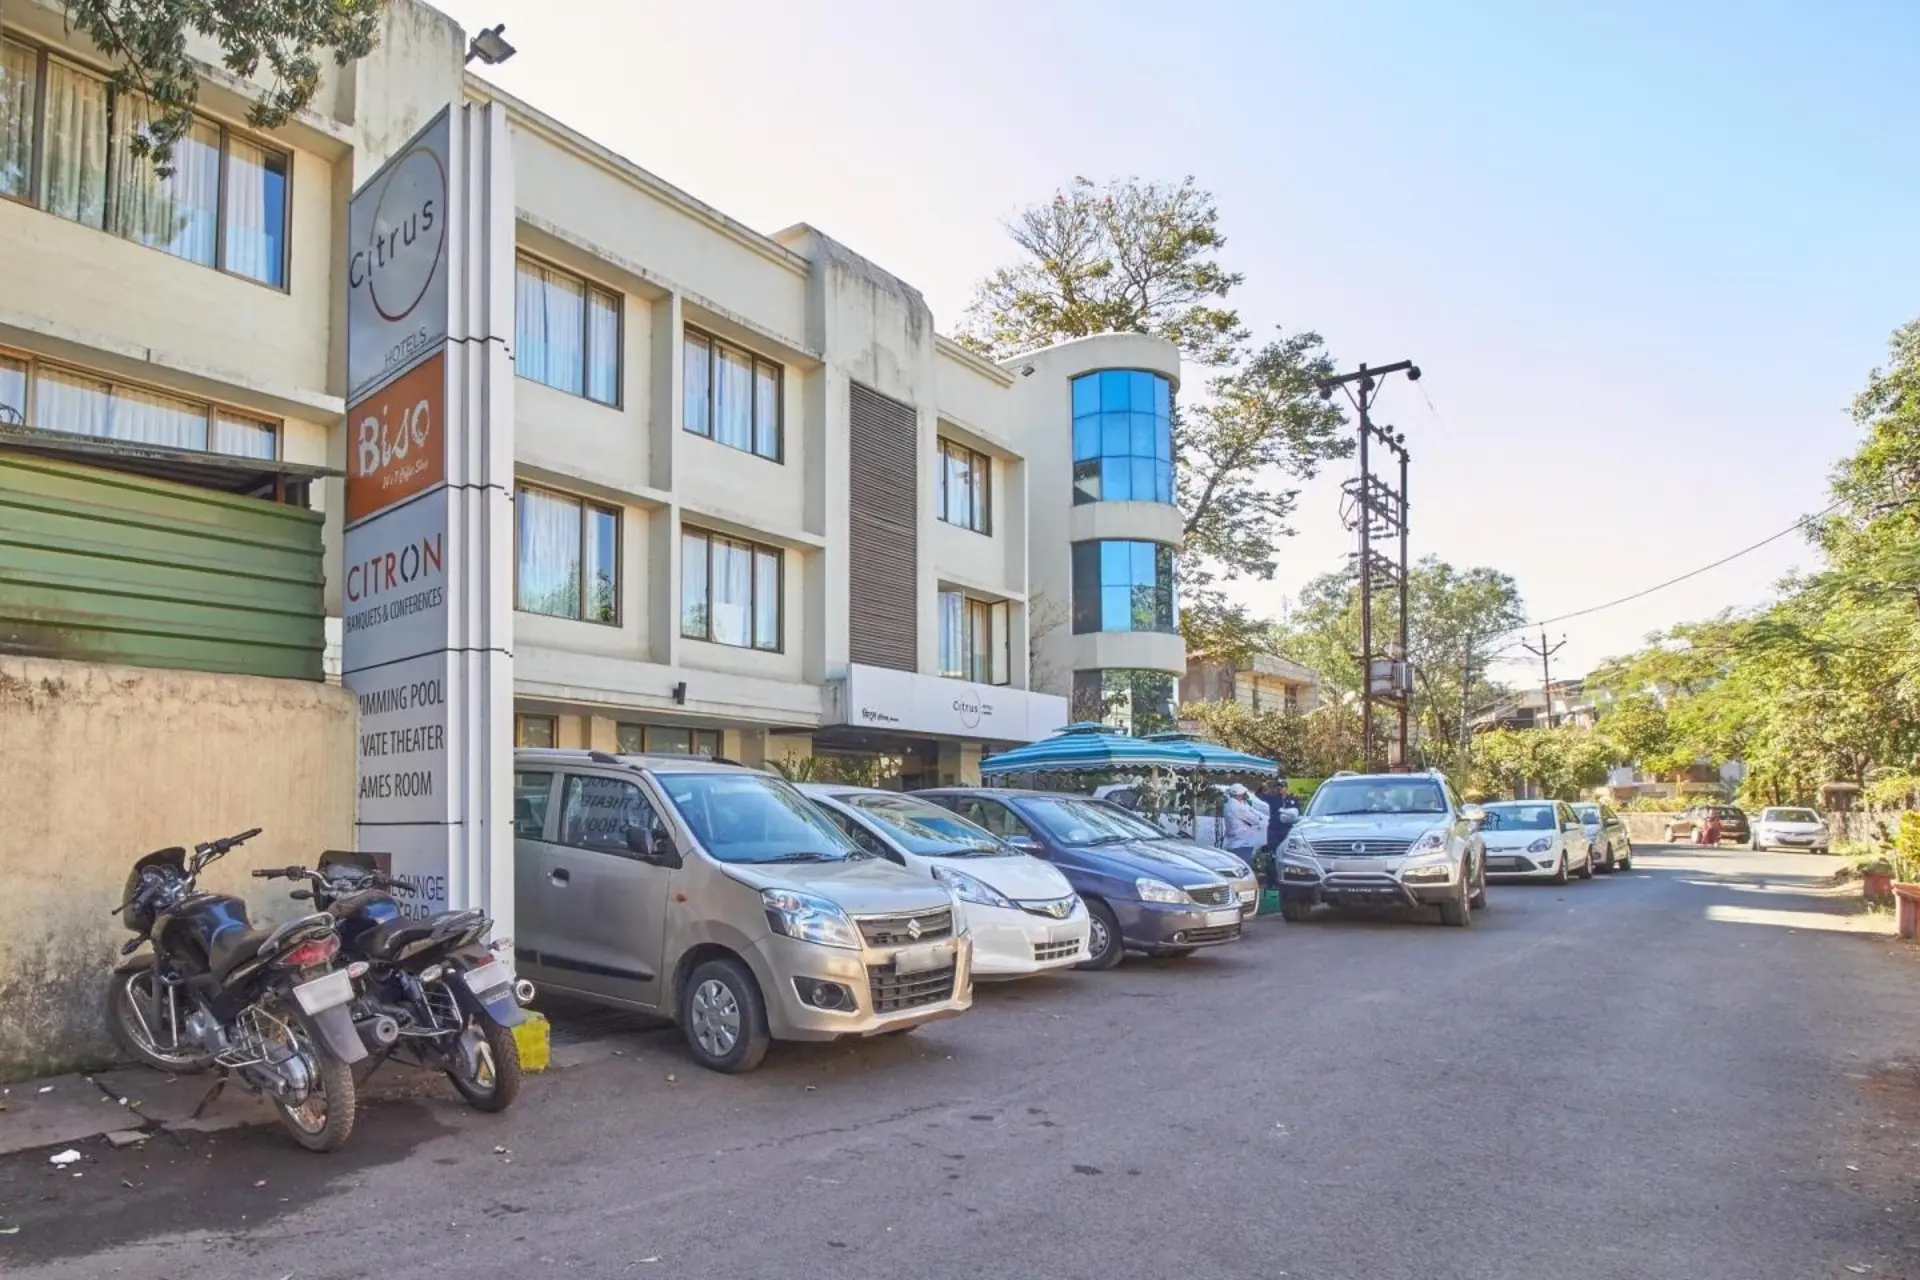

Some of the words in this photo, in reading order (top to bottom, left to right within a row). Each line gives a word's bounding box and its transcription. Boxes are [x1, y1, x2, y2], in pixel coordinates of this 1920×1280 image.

[350, 200, 434, 288] Citrus
[385, 326, 428, 365] HOTELS
[347, 533, 442, 602] CITRON
[346, 605, 382, 634] BANQUETS
[382, 605, 389, 622] &
[390, 587, 443, 620] CONFERENCES
[359, 684, 407, 716] IMMING
[411, 679, 444, 708] POOL
[953, 700, 979, 713] Citrus
[360, 731, 388, 757] VATE
[391, 724, 444, 754] THEATER
[359, 774, 392, 799] AMES
[395, 771, 433, 797] ROOM
[391, 874, 445, 901] LOUNGE
